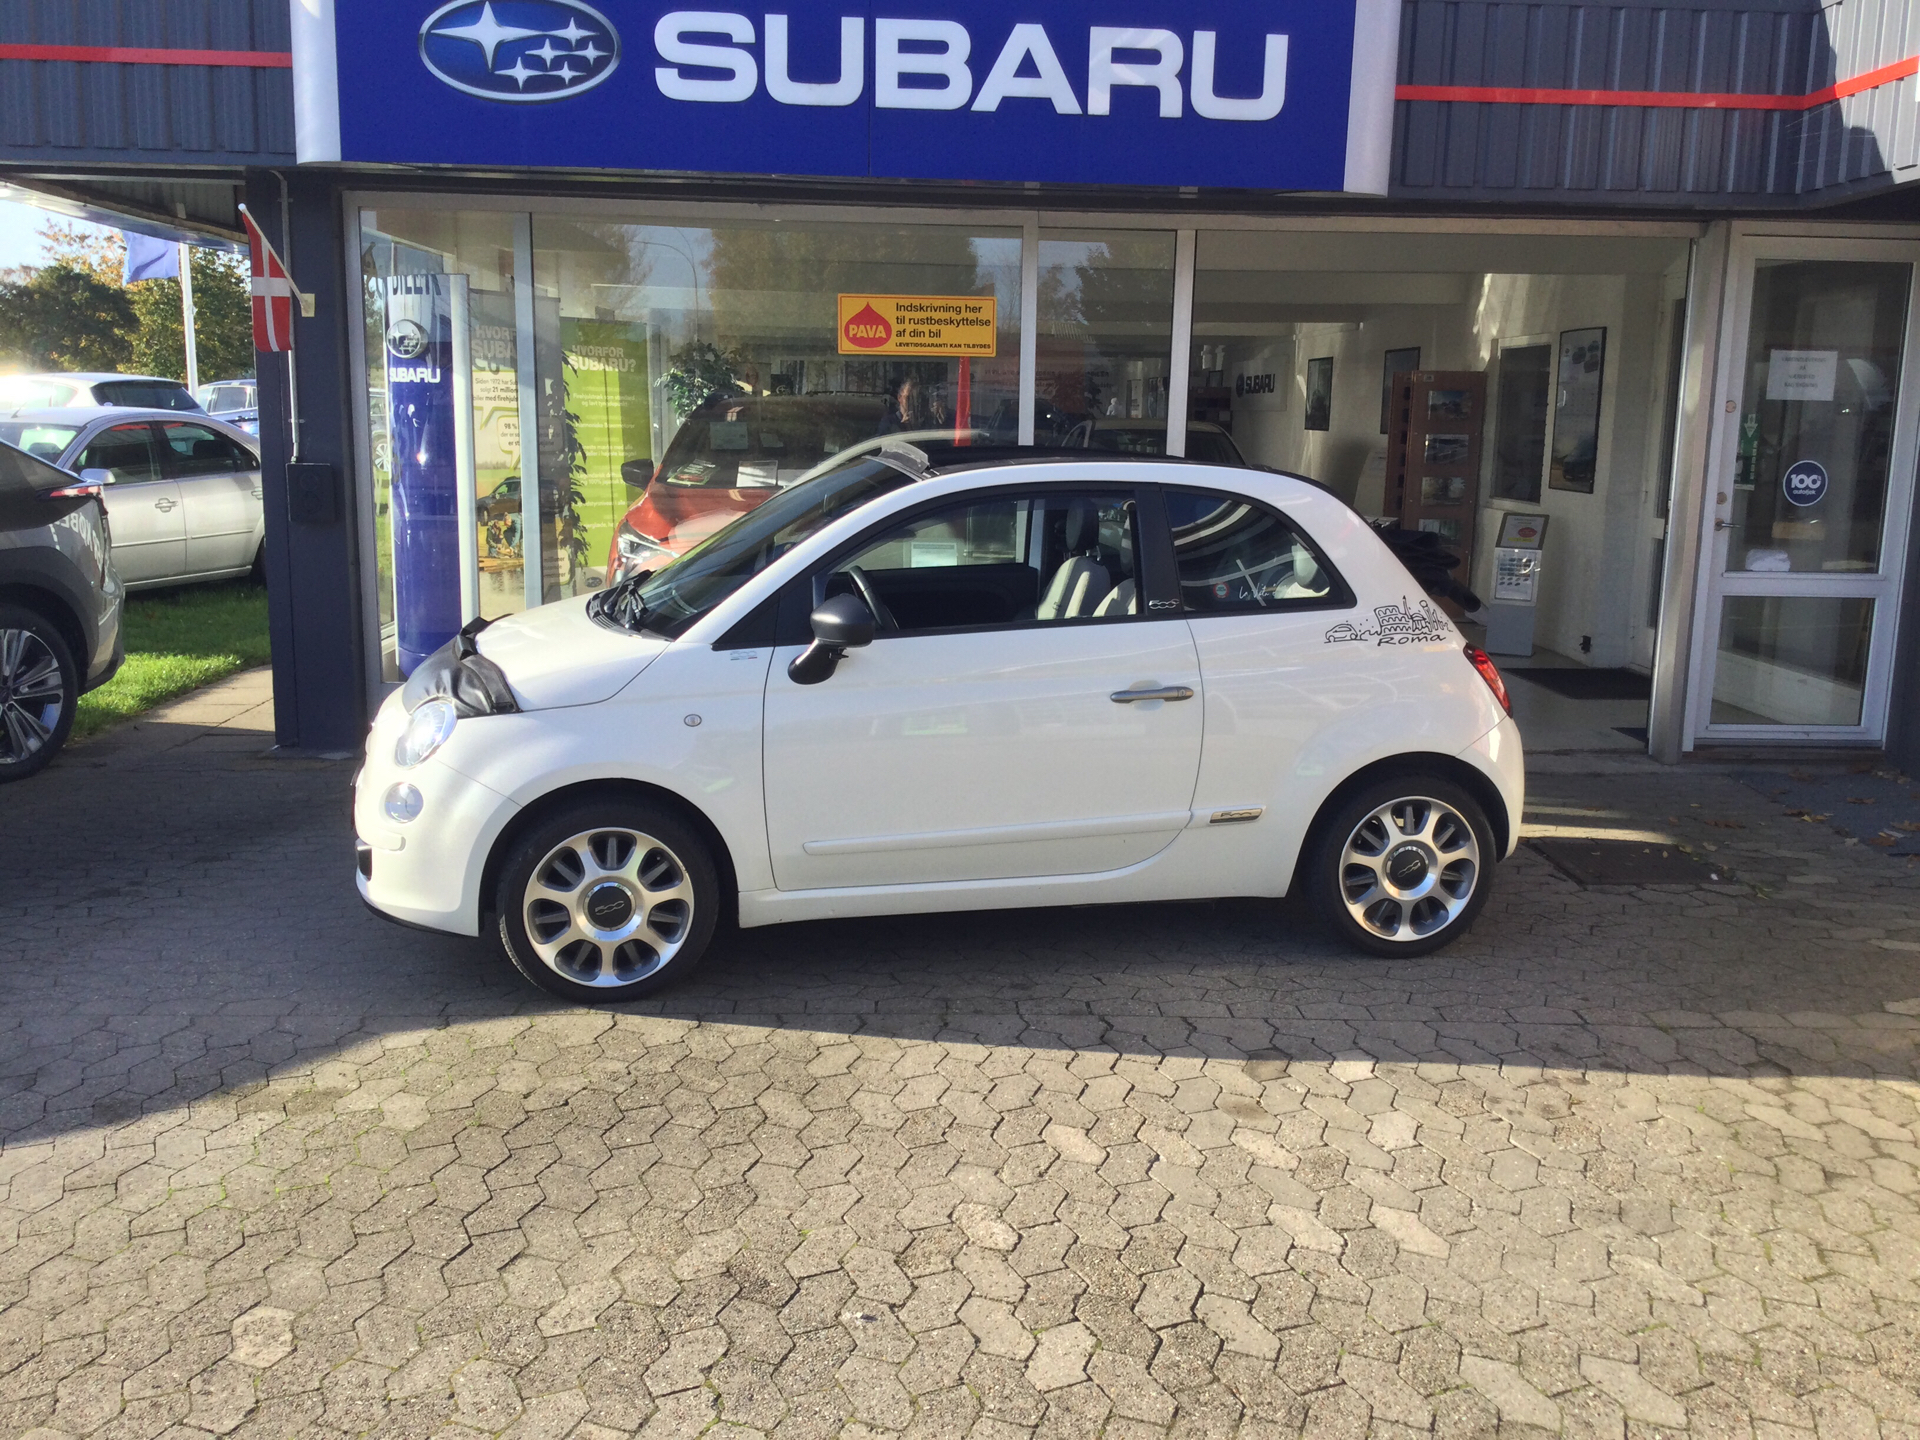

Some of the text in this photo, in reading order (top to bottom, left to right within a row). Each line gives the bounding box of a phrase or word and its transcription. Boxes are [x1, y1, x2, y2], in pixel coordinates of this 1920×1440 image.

[653, 11, 1290, 121] SUBARU
[896, 303, 983, 315] Indskrivning her
[896, 316, 991, 328] til rustbeskyttelse
[475, 325, 517, 340] HVORF
[848, 324, 887, 339] PAVA
[896, 328, 942, 338] af din bil
[471, 340, 518, 359] SUBA
[572, 344, 624, 358] HVORFOR
[567, 355, 637, 372] SUBARU?
[389, 367, 441, 383] SUBARU
[1245, 373, 1276, 394] SUBARU
